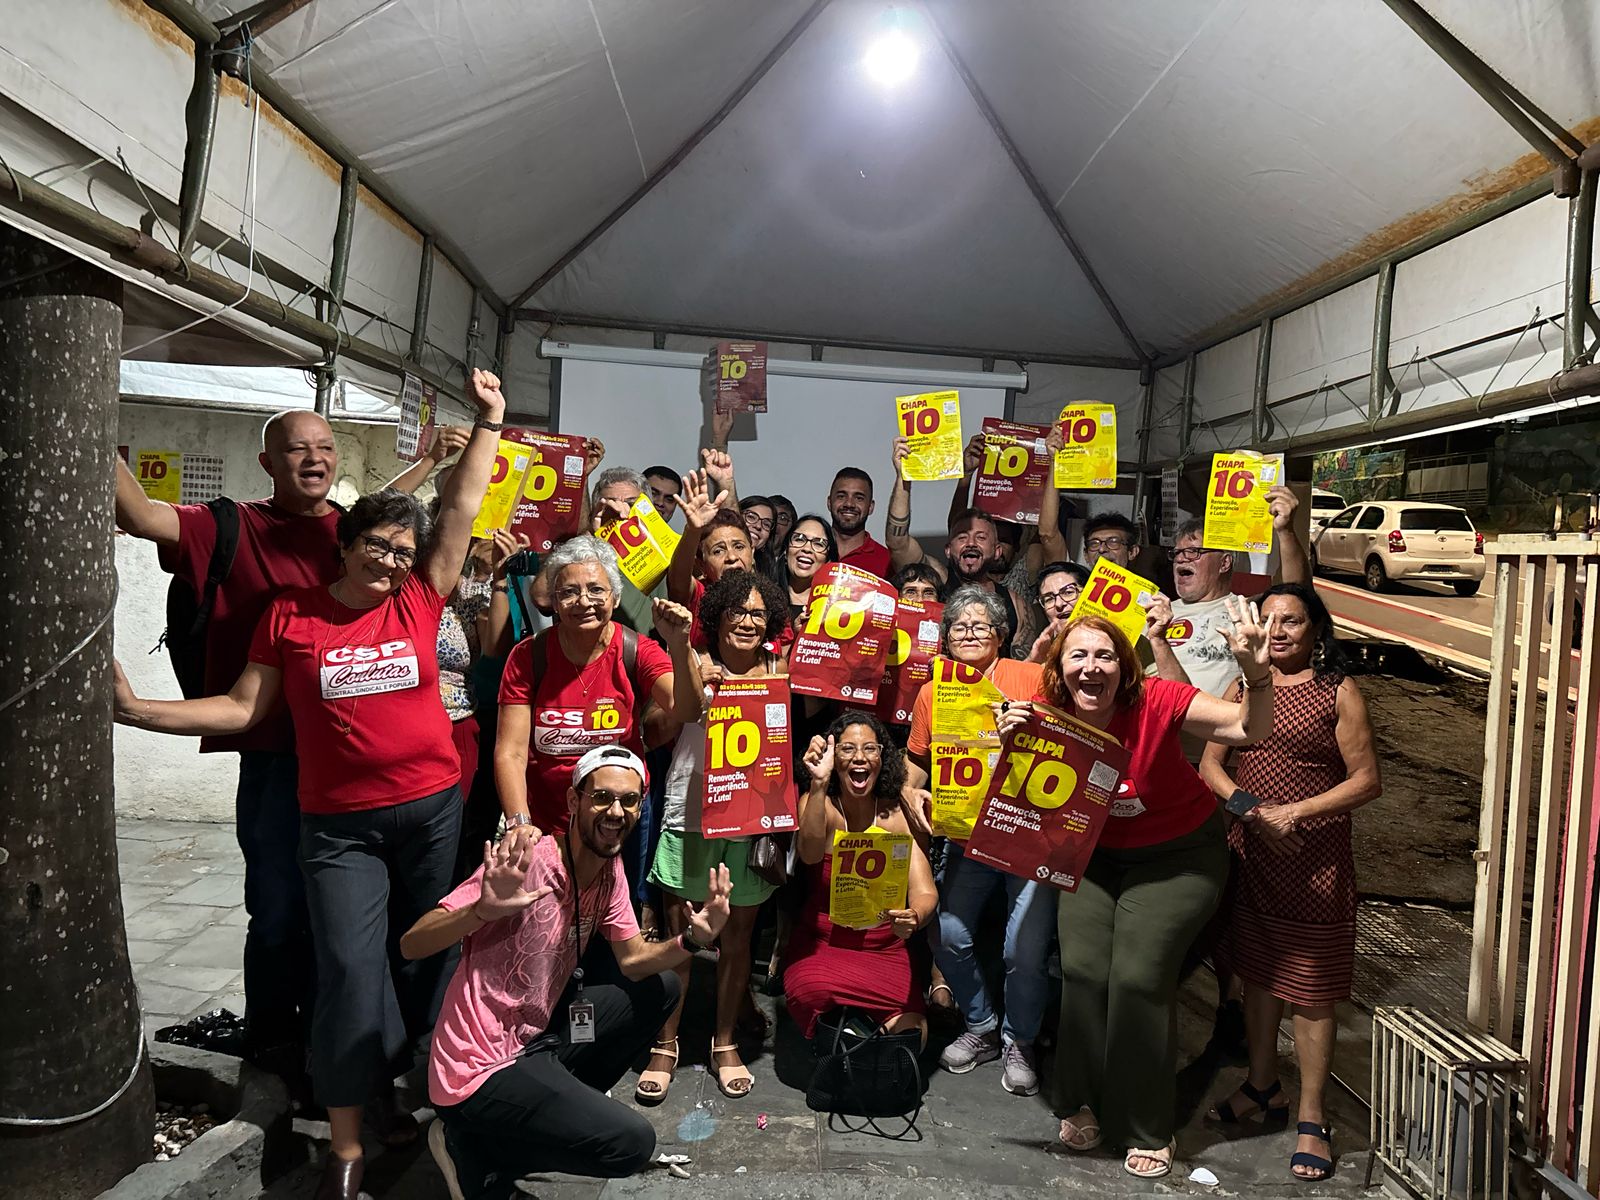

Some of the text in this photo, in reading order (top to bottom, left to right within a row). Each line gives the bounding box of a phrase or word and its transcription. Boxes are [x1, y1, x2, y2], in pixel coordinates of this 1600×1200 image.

[720, 360, 747, 379] 10
[901, 399, 928, 410] CHAPA
[902, 408, 940, 437] 10
[1061, 418, 1097, 444] 10
[985, 433, 1017, 445] CHAPA
[140, 461, 167, 480] 10
[983, 446, 1029, 478] 10
[1216, 460, 1245, 468] CHAPA
[978, 484, 1013, 492] Experiência
[979, 477, 1012, 486] Renovação,
[1214, 470, 1255, 499] 10
[982, 490, 999, 498] Luta!
[608, 515, 649, 560] 10
[622, 545, 648, 568] Renovação,
[627, 548, 654, 573] Experiência
[1098, 565, 1127, 584] CHAPA
[813, 584, 851, 599] CHAPA
[1087, 576, 1132, 613] 10
[804, 596, 865, 640] 10
[1165, 626, 1186, 639] 10
[326, 641, 407, 663] CSP
[796, 646, 841, 659] Experiência
[798, 637, 840, 651] Renovação,
[801, 655, 822, 665] Luta!
[329, 663, 411, 688] Conlutas
[326, 688, 355, 697] CENTRAL
[355, 686, 382, 694] SINDICAL
[389, 680, 416, 689] POPULAR
[937, 684, 970, 692] Renovação,
[591, 709, 620, 730] 10
[708, 706, 742, 721] CHAPA
[1040, 721, 1065, 734] ELEIÇÕES
[1045, 715, 1054, 723] 02
[1059, 719, 1067, 728] 03
[1075, 726, 1090, 738] Abril
[1090, 735, 1105, 746] 2025
[708, 720, 761, 769] 10
[936, 746, 969, 755] CHAPA
[1014, 732, 1065, 759] CHAPA
[708, 771, 747, 783] Renovação,
[936, 756, 983, 787] 10
[708, 781, 749, 794] Experiência
[1000, 752, 1078, 809] 10
[713, 792, 732, 802] Luta!
[936, 788, 967, 796] Renovação,
[936, 793, 970, 801] Experiência
[989, 797, 1042, 822] Renovação,
[986, 807, 1041, 832] Experiência
[990, 820, 1017, 834] Luta!
[839, 839, 874, 848] CHAPA
[837, 850, 887, 880] 10
[835, 876, 869, 886] Renovação,
